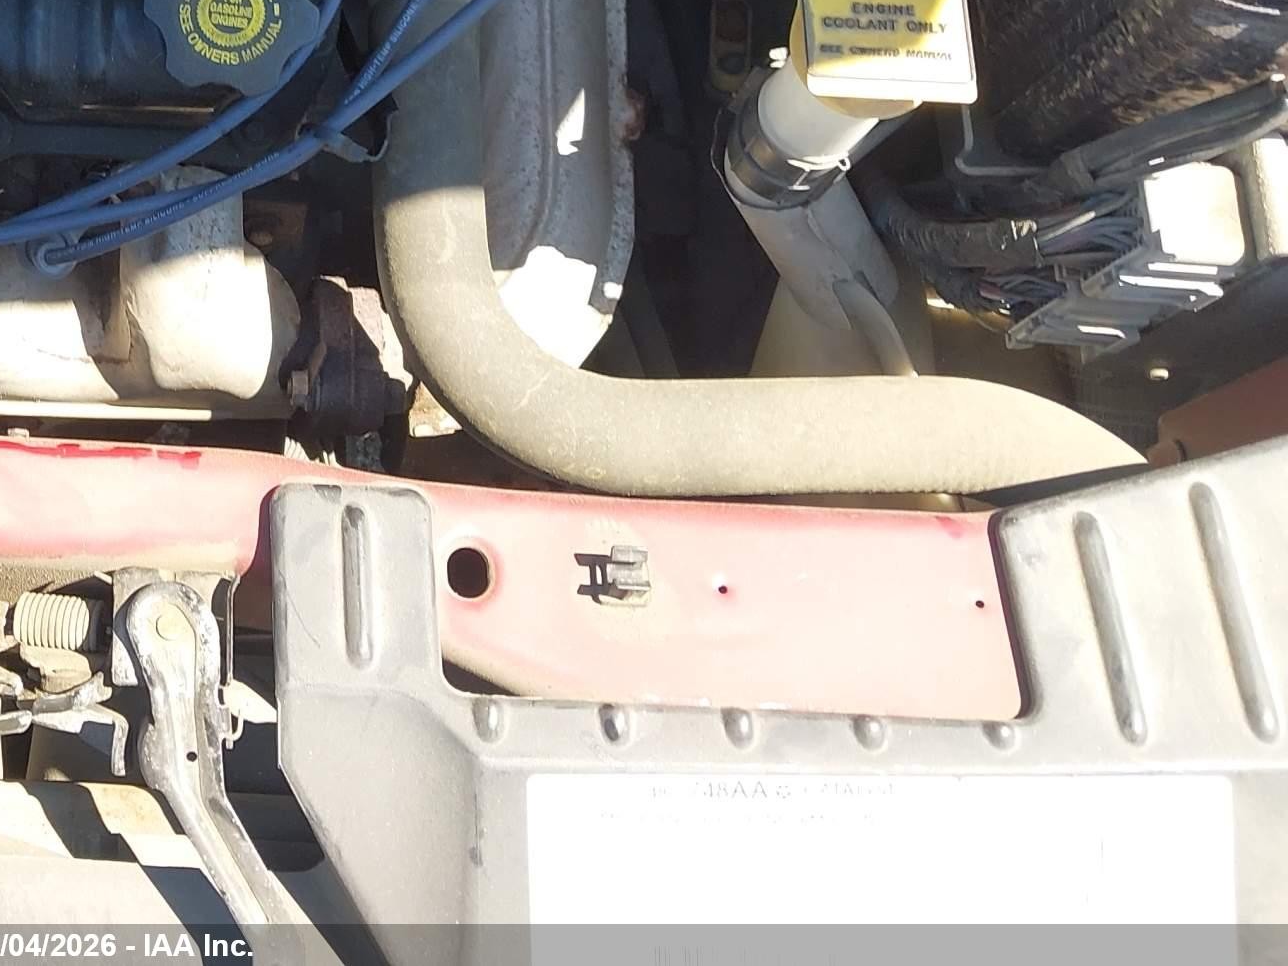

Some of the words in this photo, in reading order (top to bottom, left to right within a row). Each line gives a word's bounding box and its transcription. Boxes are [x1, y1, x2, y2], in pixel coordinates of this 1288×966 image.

[210, 1, 253, 19] GASOLINE
[851, 2, 916, 16] ENGINE
[210, 14, 249, 29] ENGINES
[822, 16, 897, 32] COOLANT
[906, 20, 948, 35] ONLY
[179, 3, 194, 34] SEE
[187, 32, 240, 65] OWNERS
[241, 19, 282, 63] MANUAL
